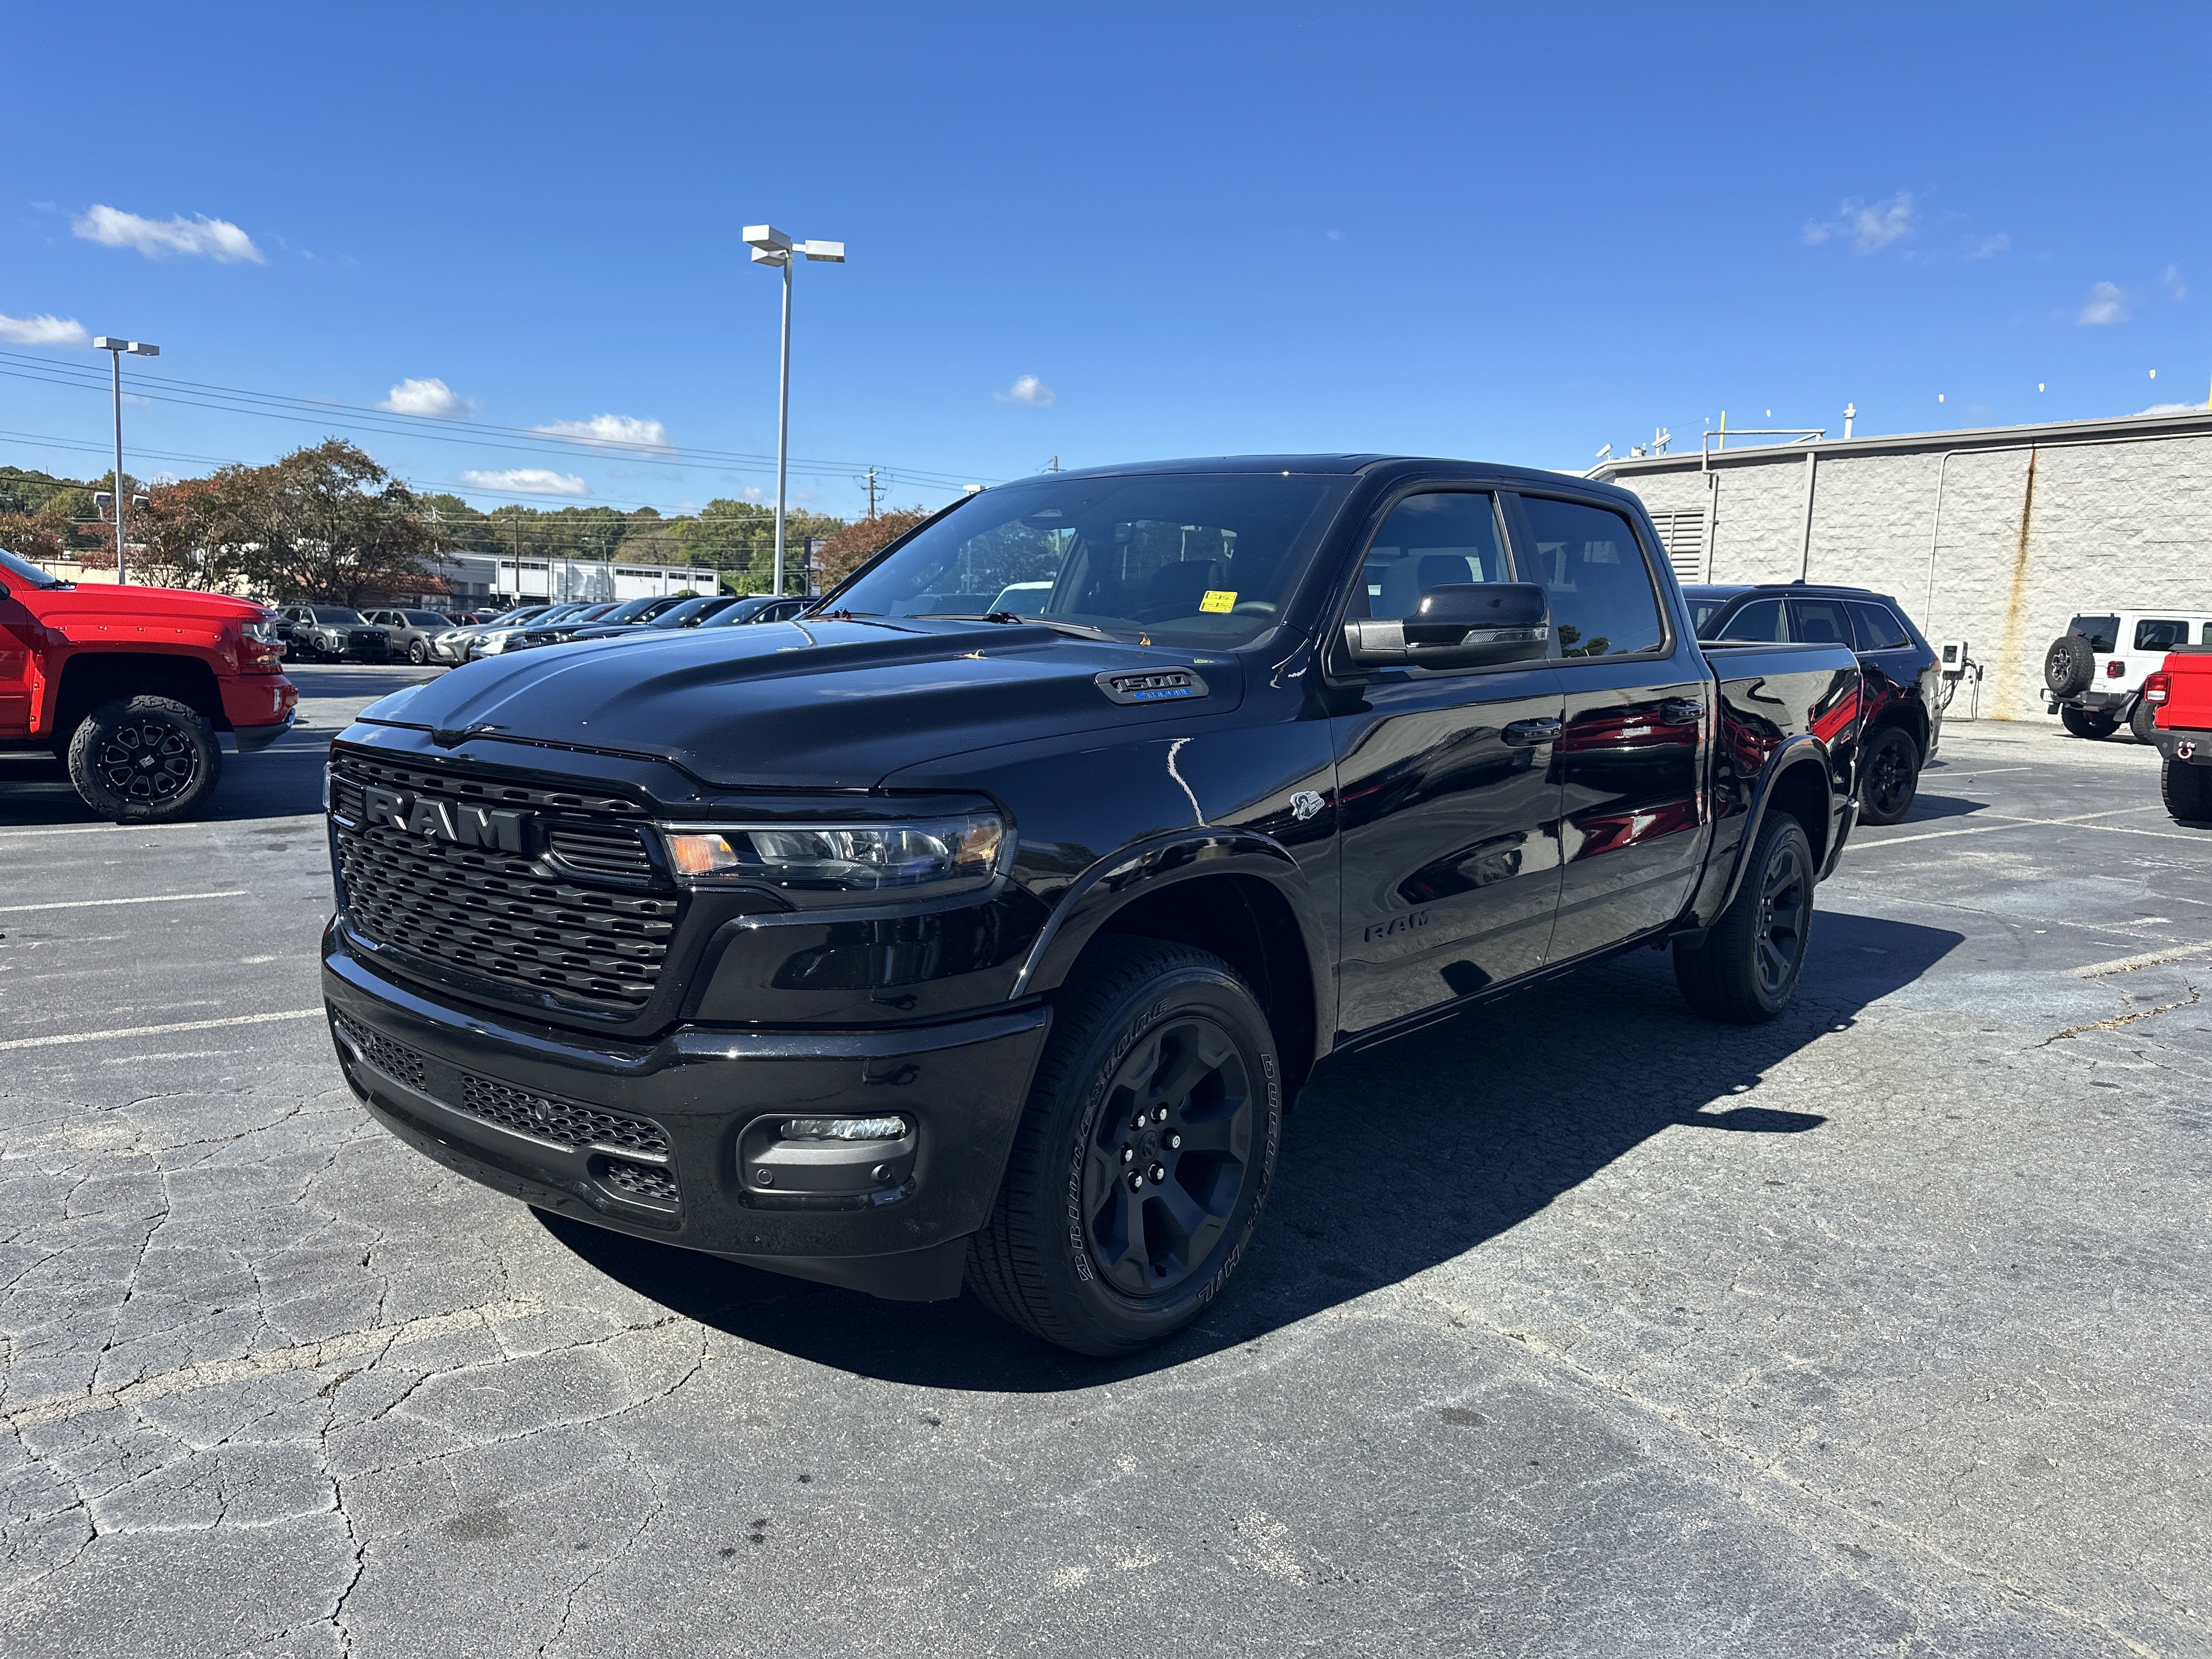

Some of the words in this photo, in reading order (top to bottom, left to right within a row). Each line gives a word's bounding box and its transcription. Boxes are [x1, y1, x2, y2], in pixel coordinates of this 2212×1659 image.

[1113, 674, 1191, 693] 1500
[365, 786, 522, 852] RAM
[1364, 909, 1432, 943] RAM
[1068, 997, 1170, 1281] BRIDGESTONE
